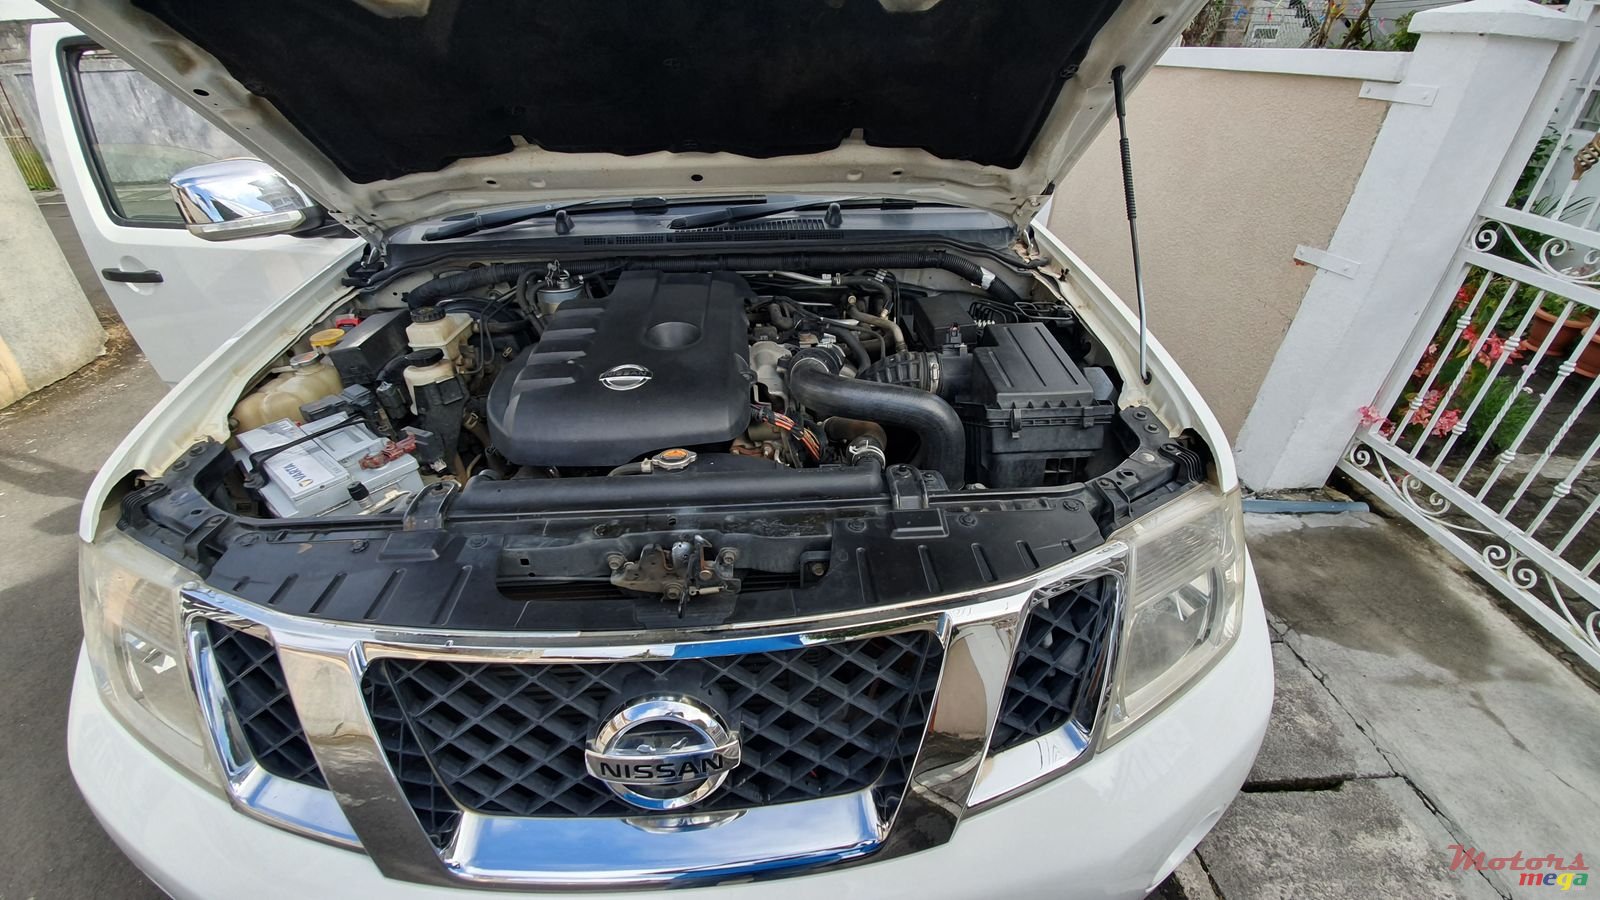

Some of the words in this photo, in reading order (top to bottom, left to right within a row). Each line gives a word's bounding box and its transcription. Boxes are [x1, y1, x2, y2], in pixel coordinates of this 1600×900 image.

[604, 369, 647, 377] NISSAN
[283, 462, 307, 482] VARTA
[599, 754, 724, 780] NISSAN
